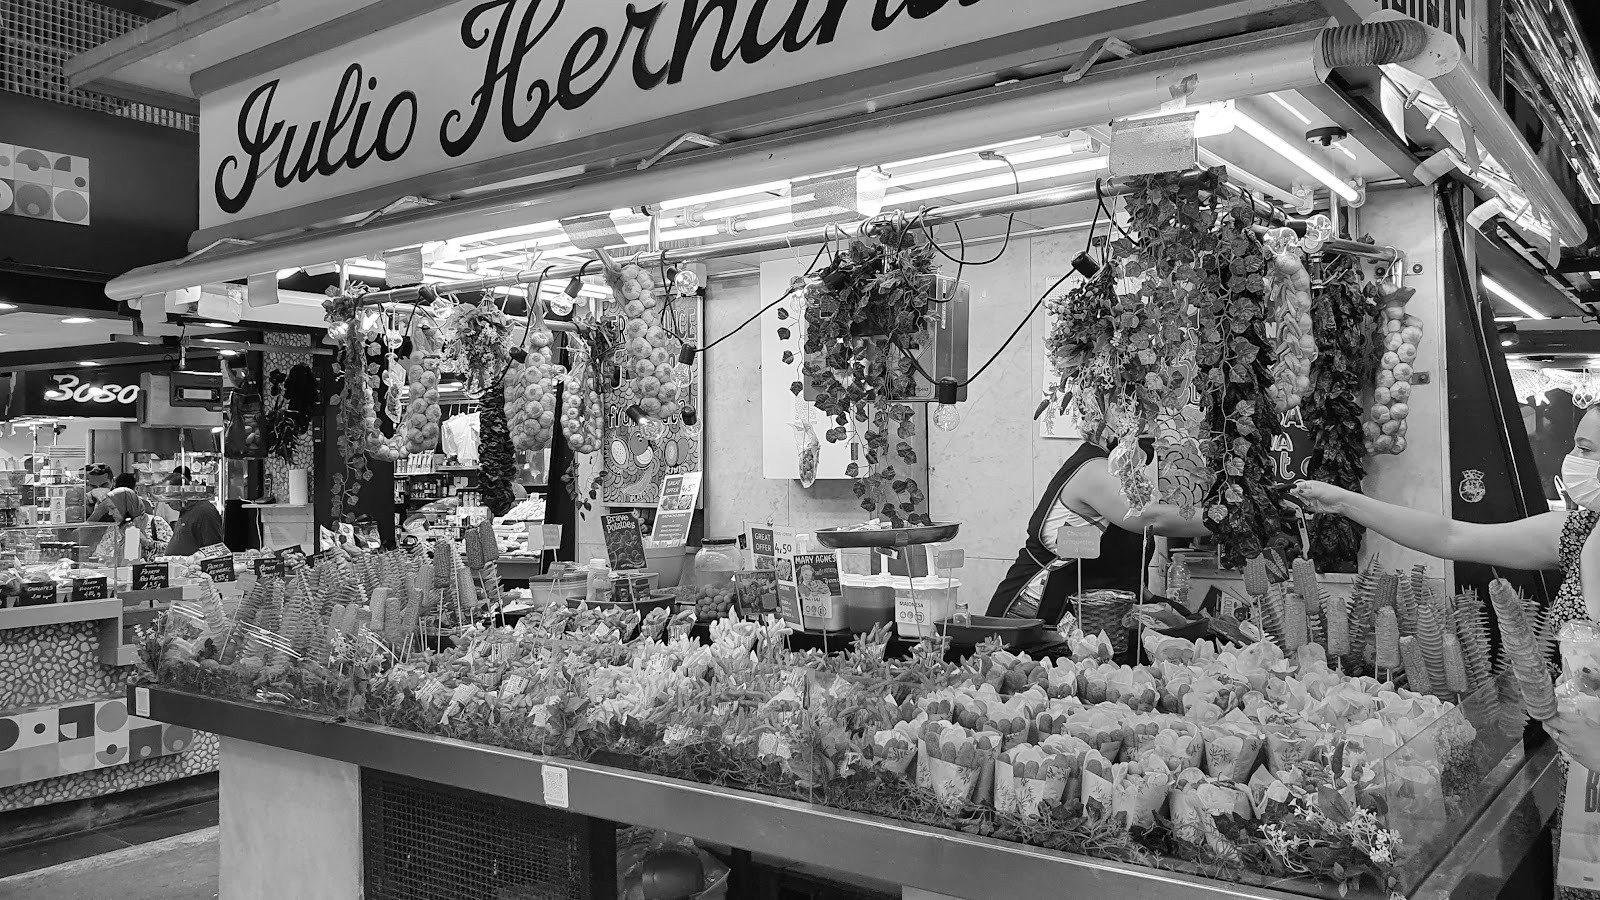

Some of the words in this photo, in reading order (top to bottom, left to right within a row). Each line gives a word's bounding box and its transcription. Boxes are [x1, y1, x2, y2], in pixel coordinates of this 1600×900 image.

[214, 63, 419, 215] Julio
[605, 515, 630, 525] Brave
[754, 532, 772, 542] GREAT
[755, 543, 773, 552] OFFER
[774, 543, 793, 555] 4,50
[795, 556, 814, 565] MARY
[815, 553, 837, 564] AGNES
